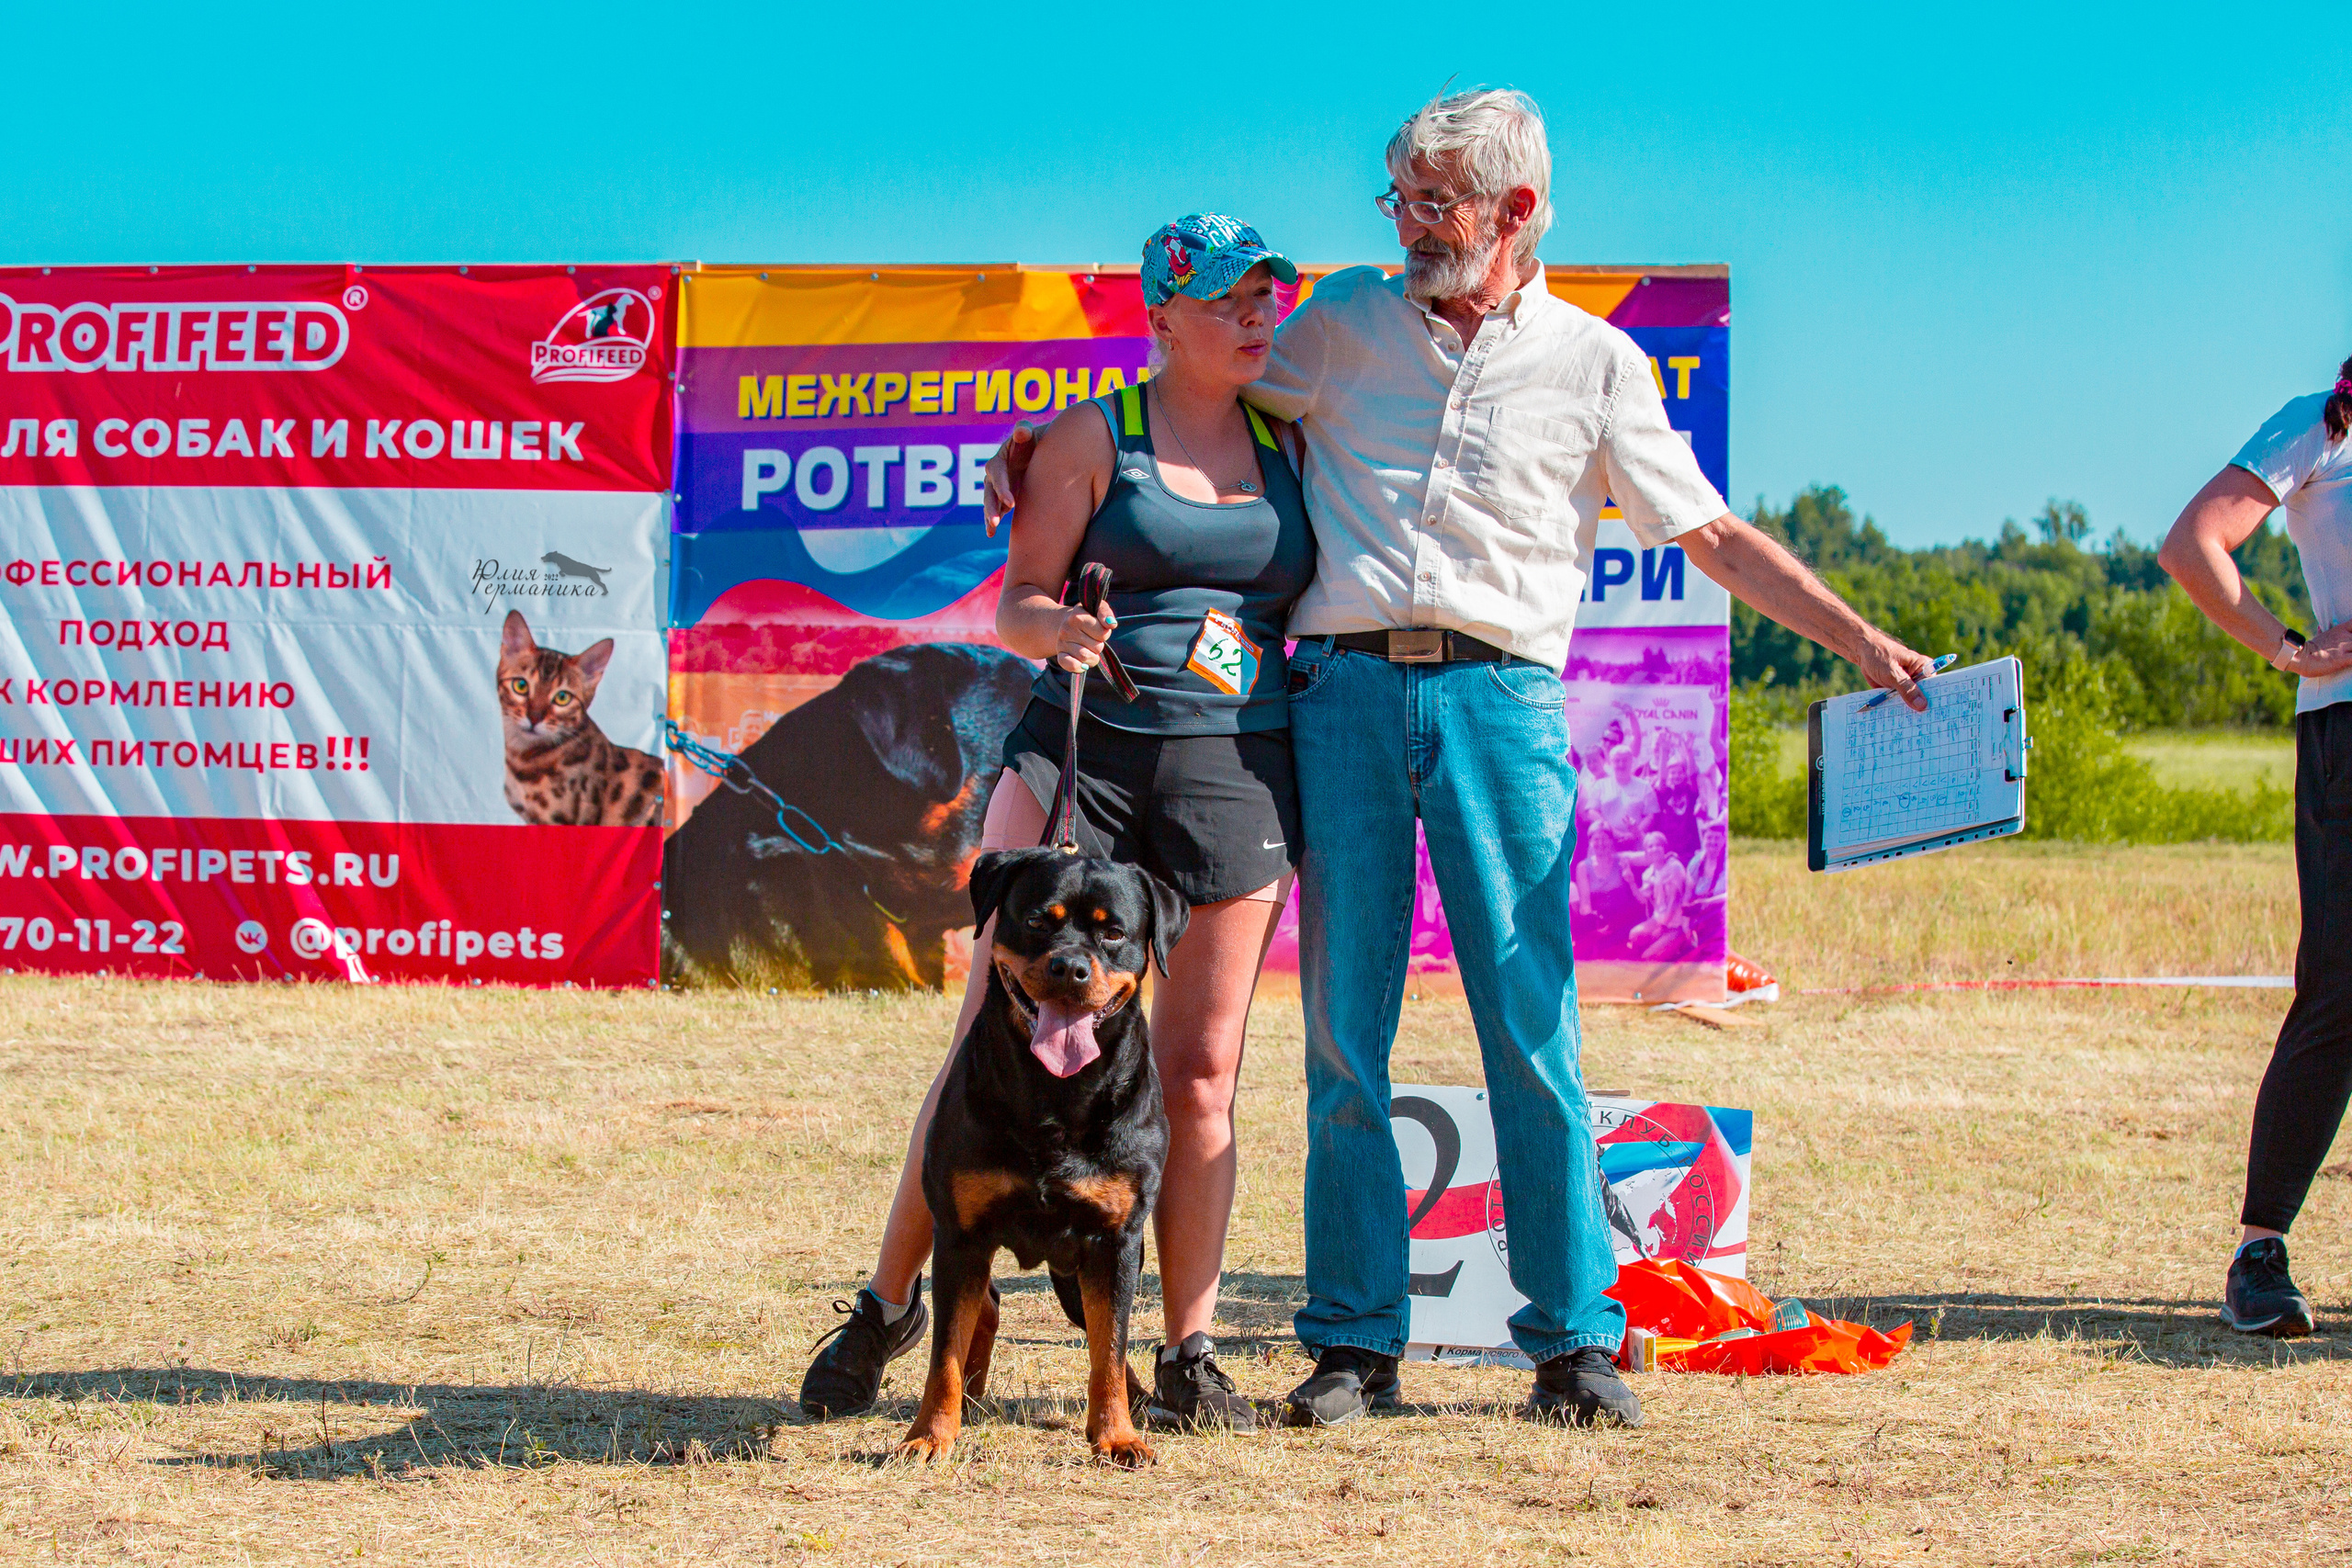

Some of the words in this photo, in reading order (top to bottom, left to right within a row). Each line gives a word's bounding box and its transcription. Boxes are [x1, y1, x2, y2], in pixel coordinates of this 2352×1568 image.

[532, 342, 645, 367] PROFIFEED
[738, 367, 1150, 419] МЕЖРЕГИОНА
[94, 418, 296, 459] СОБАК
[311, 421, 347, 458] И
[366, 421, 585, 461] КОШЕК
[0, 558, 392, 591] ФЕССИОНАЛЬНЫЙ
[1580, 547, 1685, 603] РИ
[59, 620, 230, 651] ПОДХОД
[27, 679, 296, 710] КОРМЛЕНИЮ
[91, 737, 370, 773] ПИТОМЦЕВ!!!
[290, 918, 564, 964] @profipets
[1600, 1111, 1675, 1148] КЛУБ
[1678, 1156, 1711, 1268] РОССИИ
[1446, 1347, 1481, 1357] Корма
